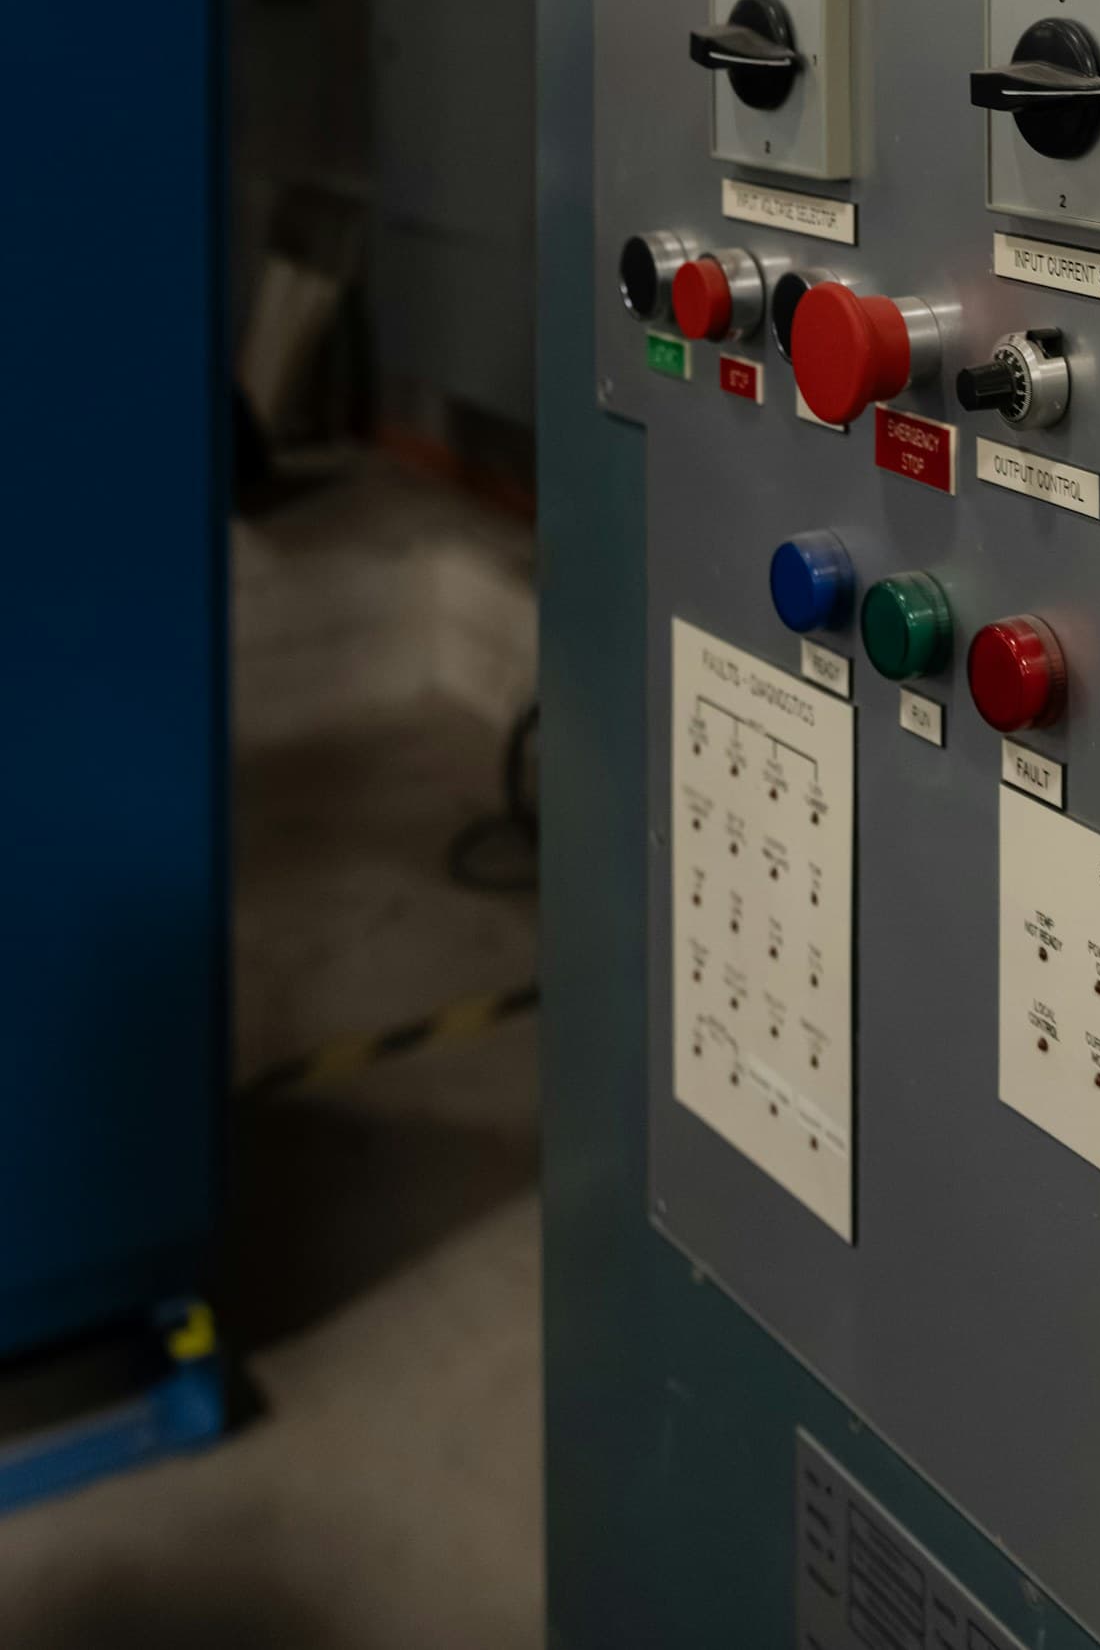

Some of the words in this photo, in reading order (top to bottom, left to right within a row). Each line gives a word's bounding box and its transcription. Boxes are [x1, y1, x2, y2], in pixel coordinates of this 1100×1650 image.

[1059, 194, 1068, 208] 2
[1014, 249, 1045, 274] INPUT
[1046, 254, 1097, 286] CURRENT
[887, 418, 940, 453] EMERGENCY
[901, 452, 925, 475] STOP
[994, 454, 1034, 487] OUTPUT
[1037, 468, 1085, 503] CONTROL
[1016, 757, 1050, 790] FAULT
